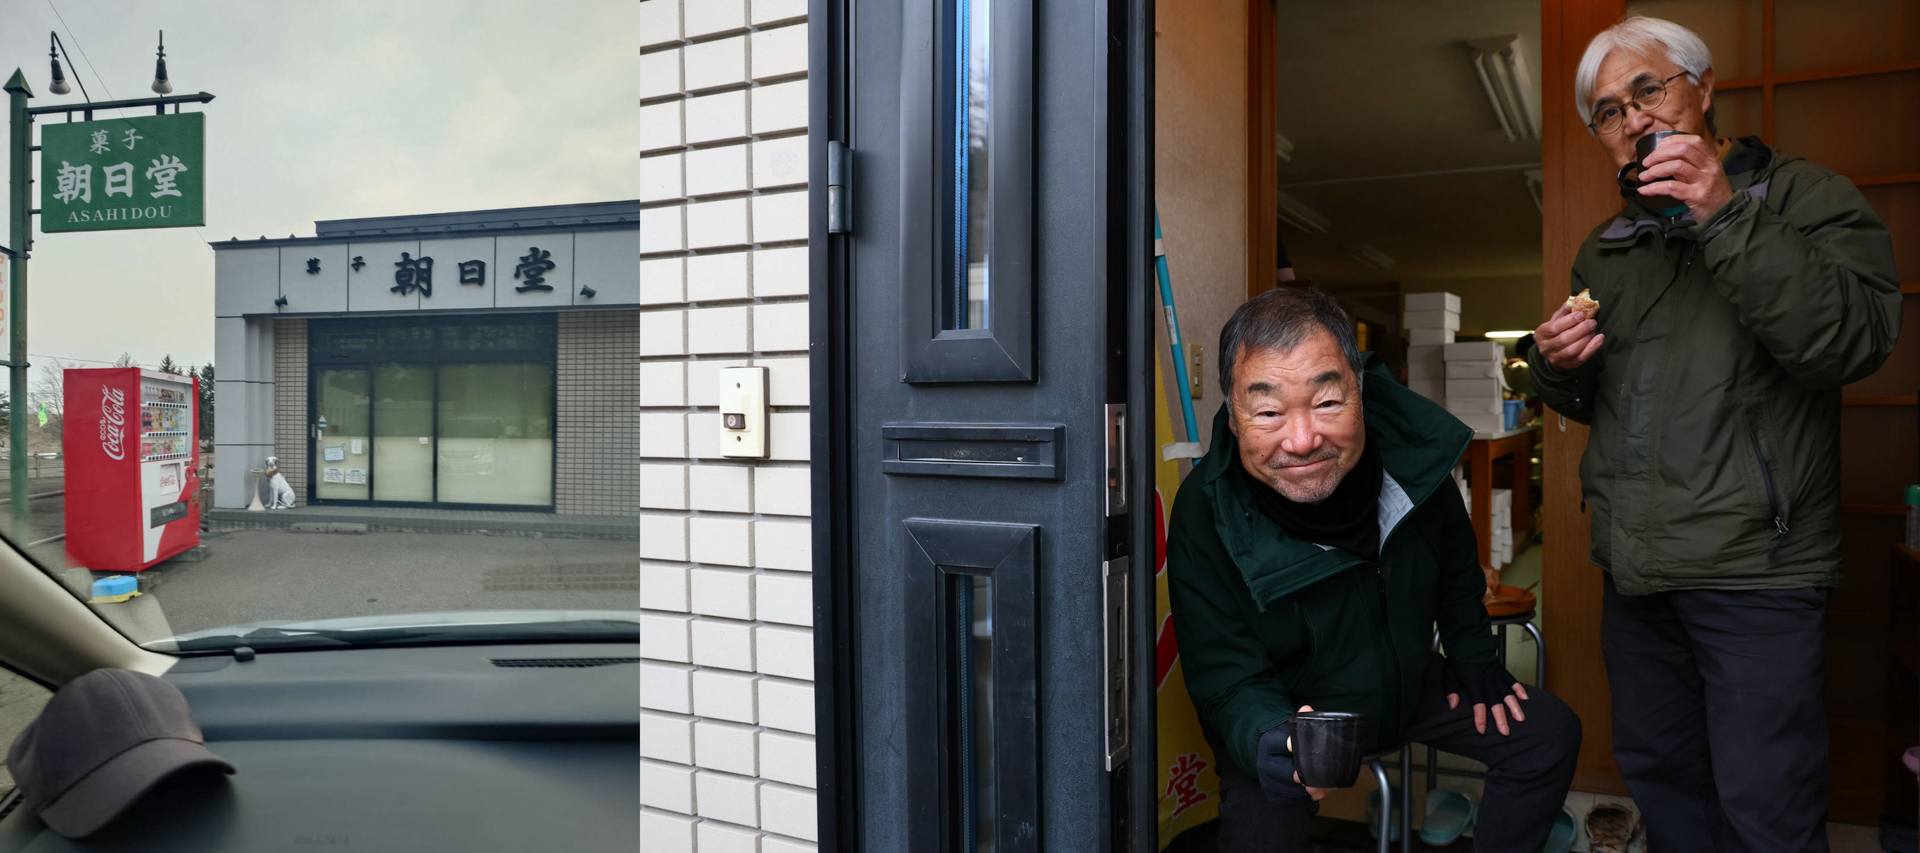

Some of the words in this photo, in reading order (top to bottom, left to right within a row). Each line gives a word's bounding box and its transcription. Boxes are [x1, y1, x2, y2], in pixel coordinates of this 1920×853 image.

[89, 128, 144, 154] 菓子
[52, 154, 188, 204] 朝日堂
[67, 205, 173, 223] ASAHIDOU
[390, 247, 556, 298] 朝日堂
[102, 384, 125, 461] Coca-Cola
[1166, 752, 1209, 819] 堂
